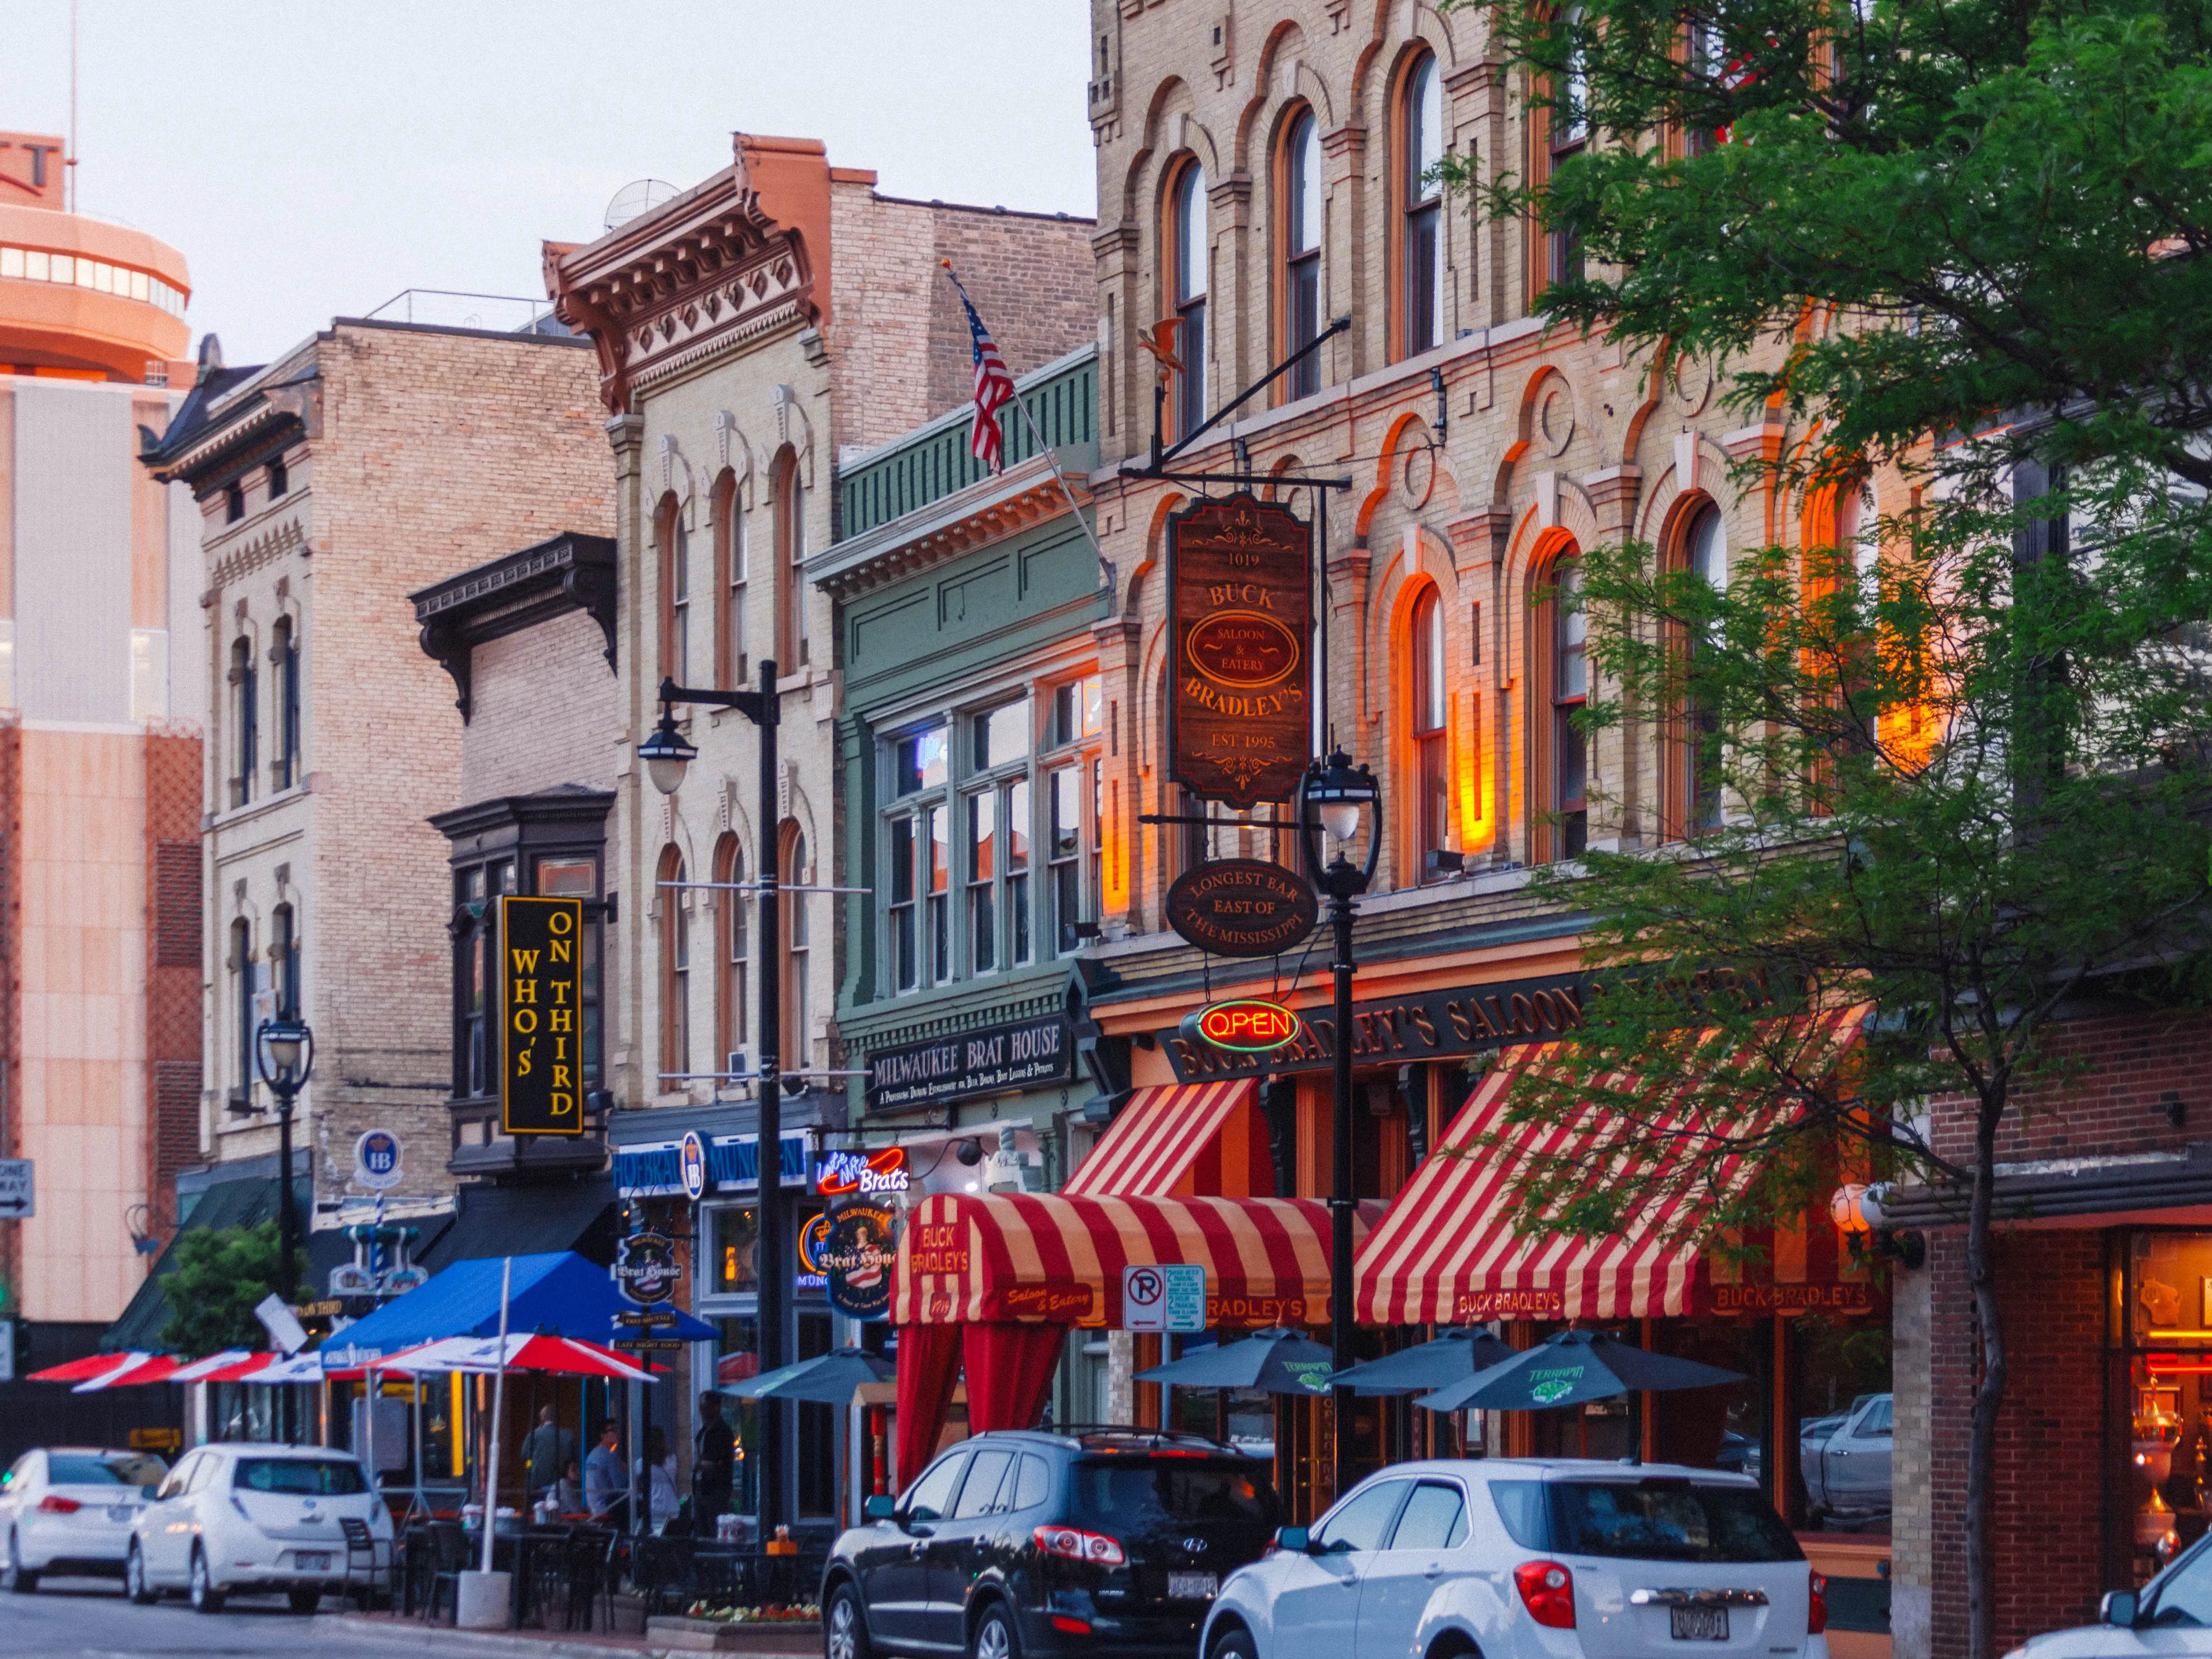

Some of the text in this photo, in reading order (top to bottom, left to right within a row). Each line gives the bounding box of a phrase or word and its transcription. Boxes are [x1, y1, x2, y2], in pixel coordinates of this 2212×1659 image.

[1229, 553, 1259, 565] 1019
[1209, 583, 1275, 609] BUCK
[1218, 629, 1265, 640] SALOON
[1236, 644, 1244, 655] &
[1222, 658, 1264, 671] EATERY
[1185, 676, 1302, 717] BRADLEY'S
[1245, 735, 1275, 748] 1995
[1190, 871, 1298, 902] LONGEST BAR
[1214, 899, 1275, 914] EAST OF
[1186, 908, 1303, 944] THE MISSISSIPPI
[511, 948, 541, 1077] WHO'S
[548, 912, 573, 1115] ON THIRD
[1447, 985, 1588, 1041] SALOON
[1208, 1012, 1289, 1036] OPEN
[874, 1025, 1060, 1087] MILWAUKEE BRAT HOUSE
[880, 1092, 884, 1105] A
[1027, 1063, 1033, 1077] &
[368, 1152, 391, 1170] HB
[859, 1168, 909, 1193] Brats
[836, 1207, 885, 1223] MILWAUKEE
[922, 1226, 955, 1248] BUCK
[819, 1253, 856, 1269] Brat
[910, 1249, 968, 1274] BRADLEY'S
[617, 1265, 681, 1279] Brat House
[1167, 1270, 1172, 1282] 2
[1008, 1288, 1047, 1304] Saloon
[1038, 1293, 1089, 1311] & Eatery
[1168, 1295, 1174, 1309] 2
[1460, 1294, 1492, 1314] BUCK
[1717, 1287, 1766, 1306] BUCK
[1207, 1299, 1302, 1316] RADLEY'S
[1529, 1365, 1584, 1382] TERRAPIN
